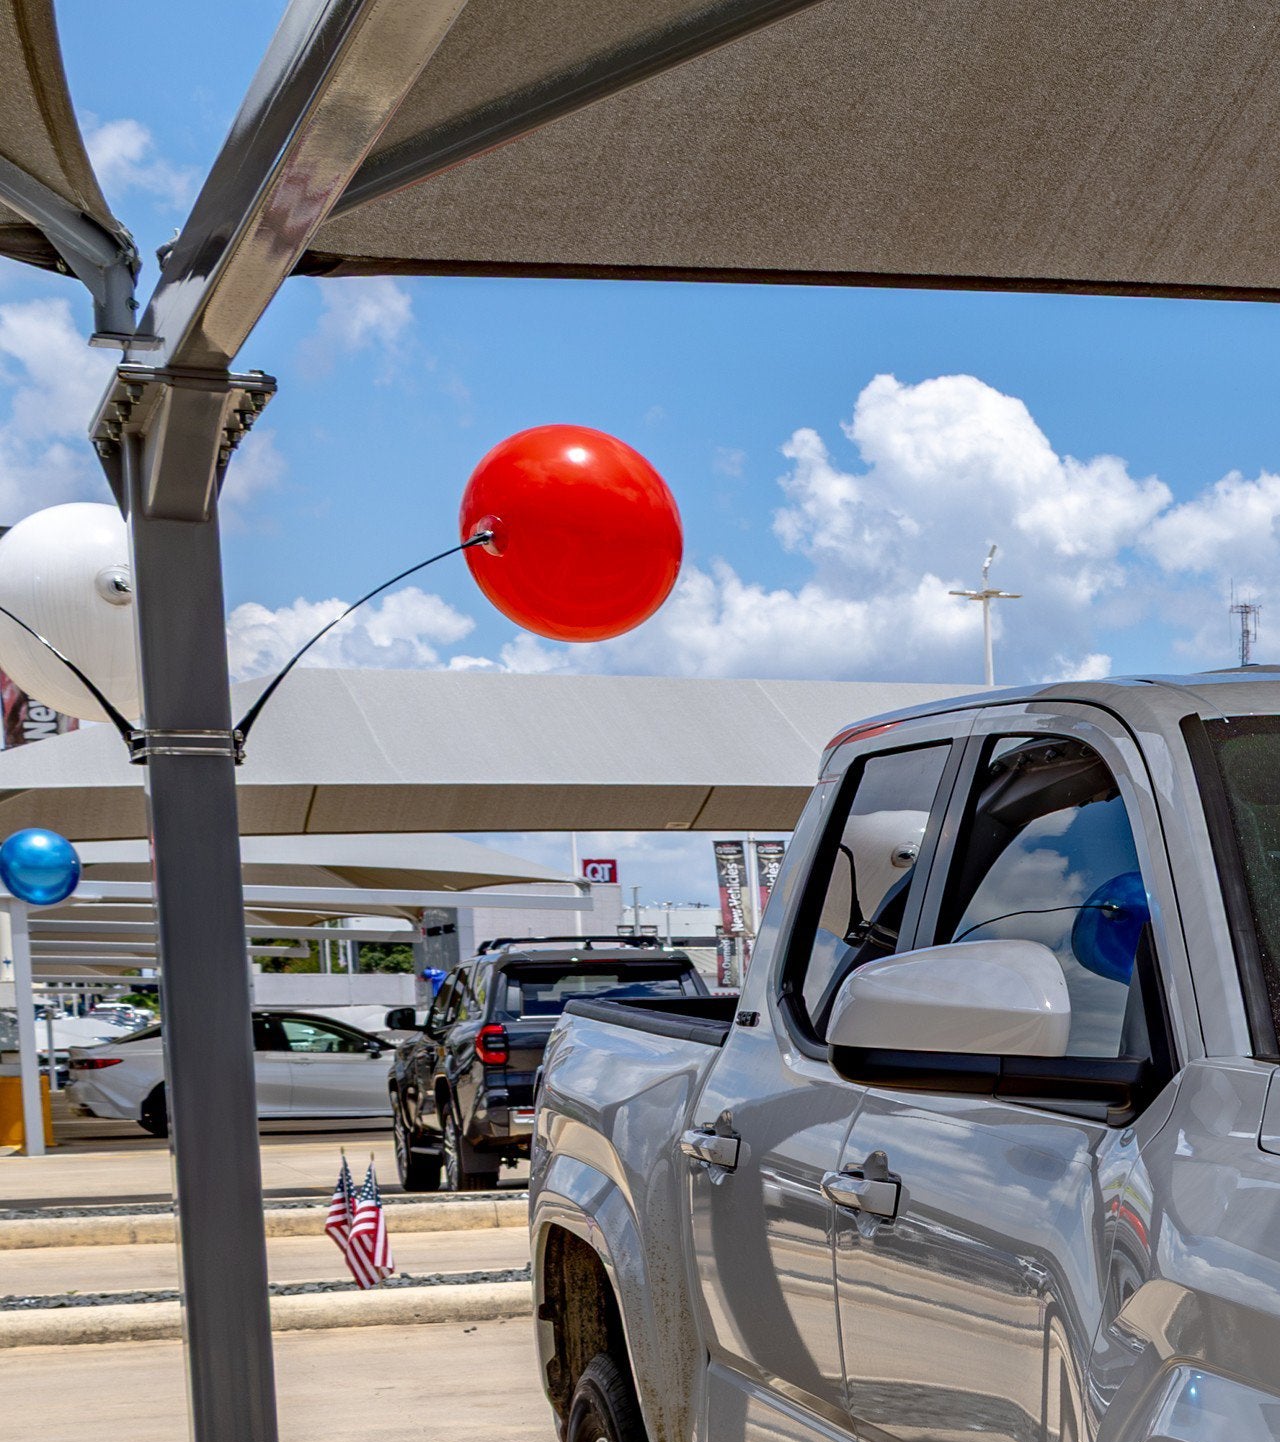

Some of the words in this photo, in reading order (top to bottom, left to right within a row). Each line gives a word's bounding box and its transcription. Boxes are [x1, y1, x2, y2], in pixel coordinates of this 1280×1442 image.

[22, 700, 58, 739] Ne
[586, 863, 612, 882] QT
[725, 862, 741, 907] Vehicles
[731, 907, 744, 931] New
